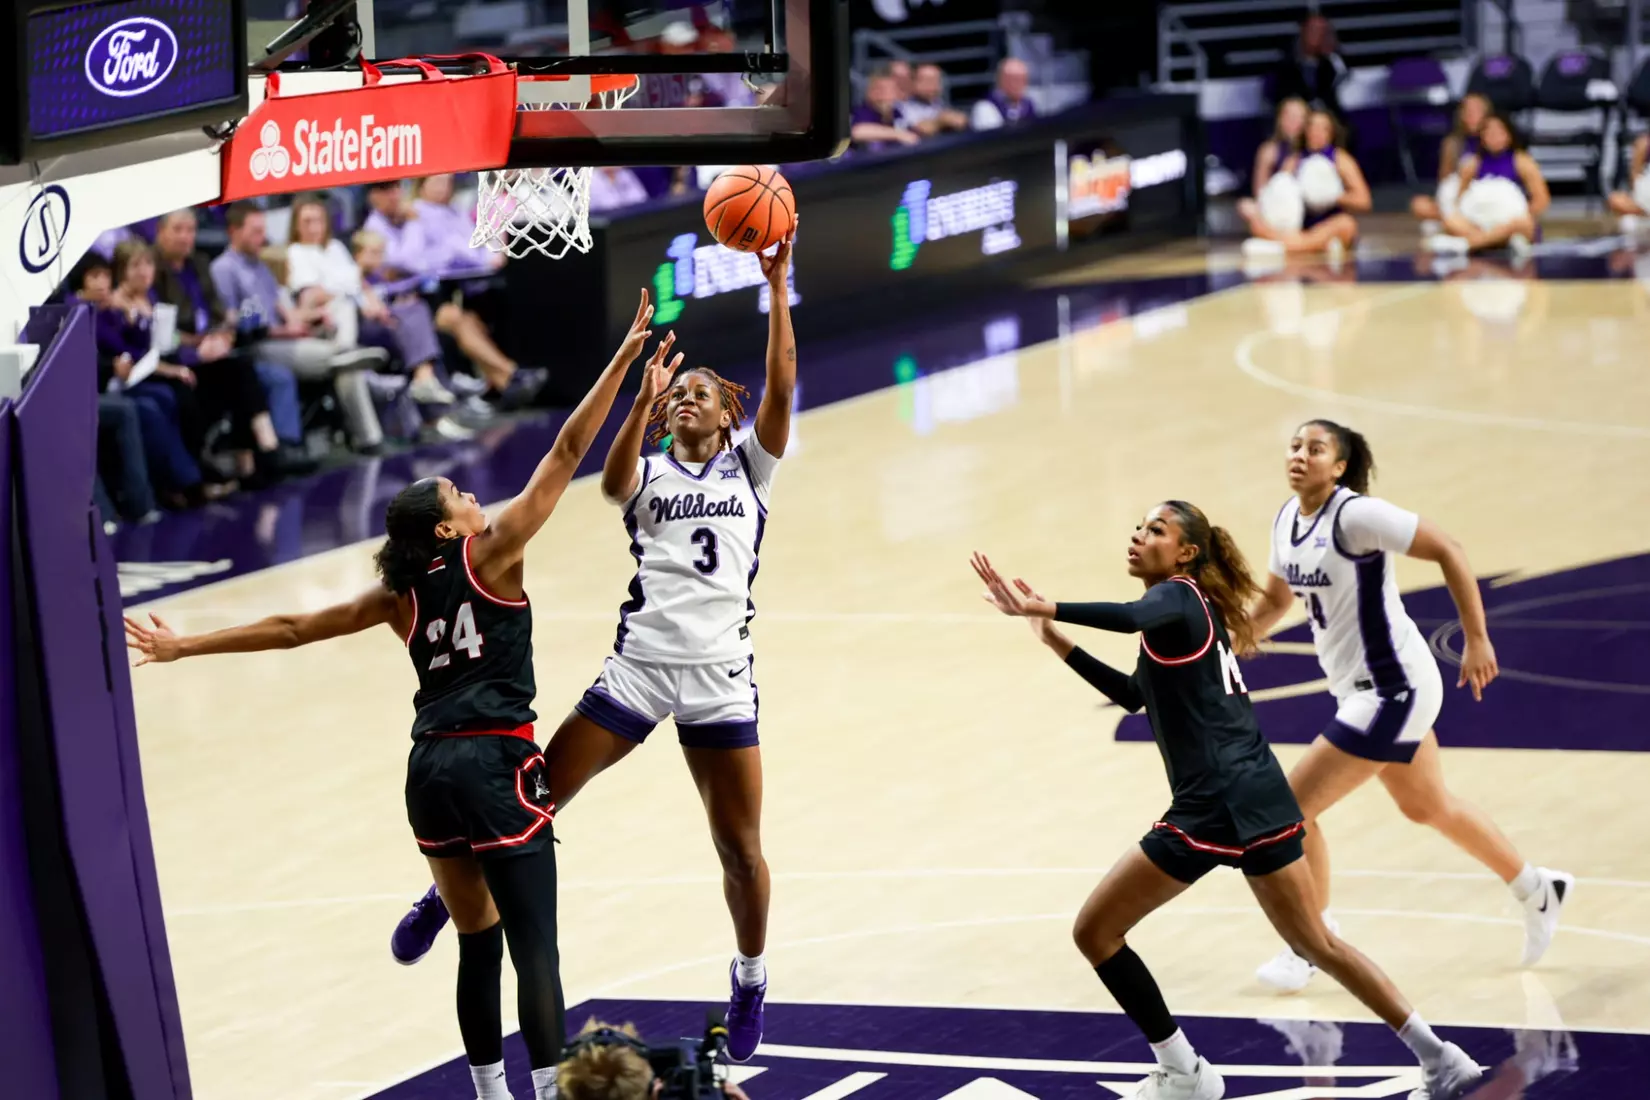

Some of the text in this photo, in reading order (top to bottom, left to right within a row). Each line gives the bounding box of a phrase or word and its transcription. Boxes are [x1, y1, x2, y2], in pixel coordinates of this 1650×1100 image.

[103, 29, 161, 85] Ford
[649, 493, 745, 524] Wildcats
[690, 527, 719, 576] 3
[426, 601, 484, 671] 24
